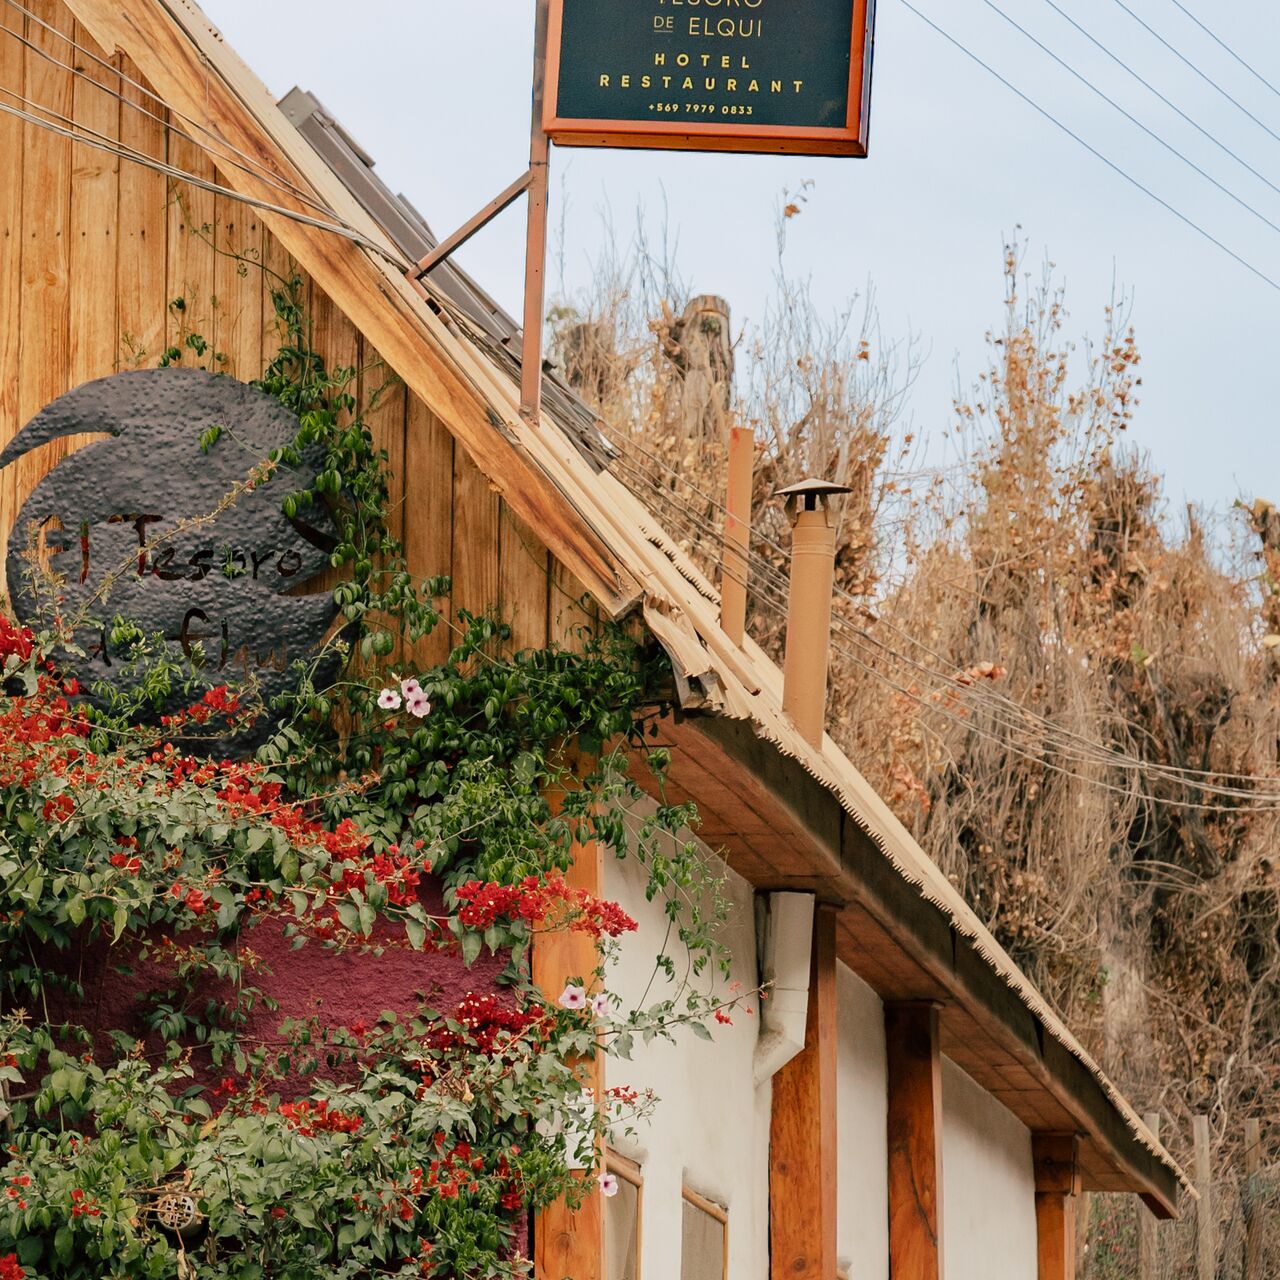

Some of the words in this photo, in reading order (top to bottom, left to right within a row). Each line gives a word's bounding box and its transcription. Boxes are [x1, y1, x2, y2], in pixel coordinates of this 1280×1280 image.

[653, 15, 674, 28] DE
[688, 16, 763, 38] ELQUI
[654, 52, 750, 69] HOTEL
[599, 73, 804, 94] RESTAURANT
[648, 103, 680, 113] +569
[685, 103, 716, 114] 7979
[721, 105, 753, 116] 0833
[106, 513, 303, 581] Tesoro
